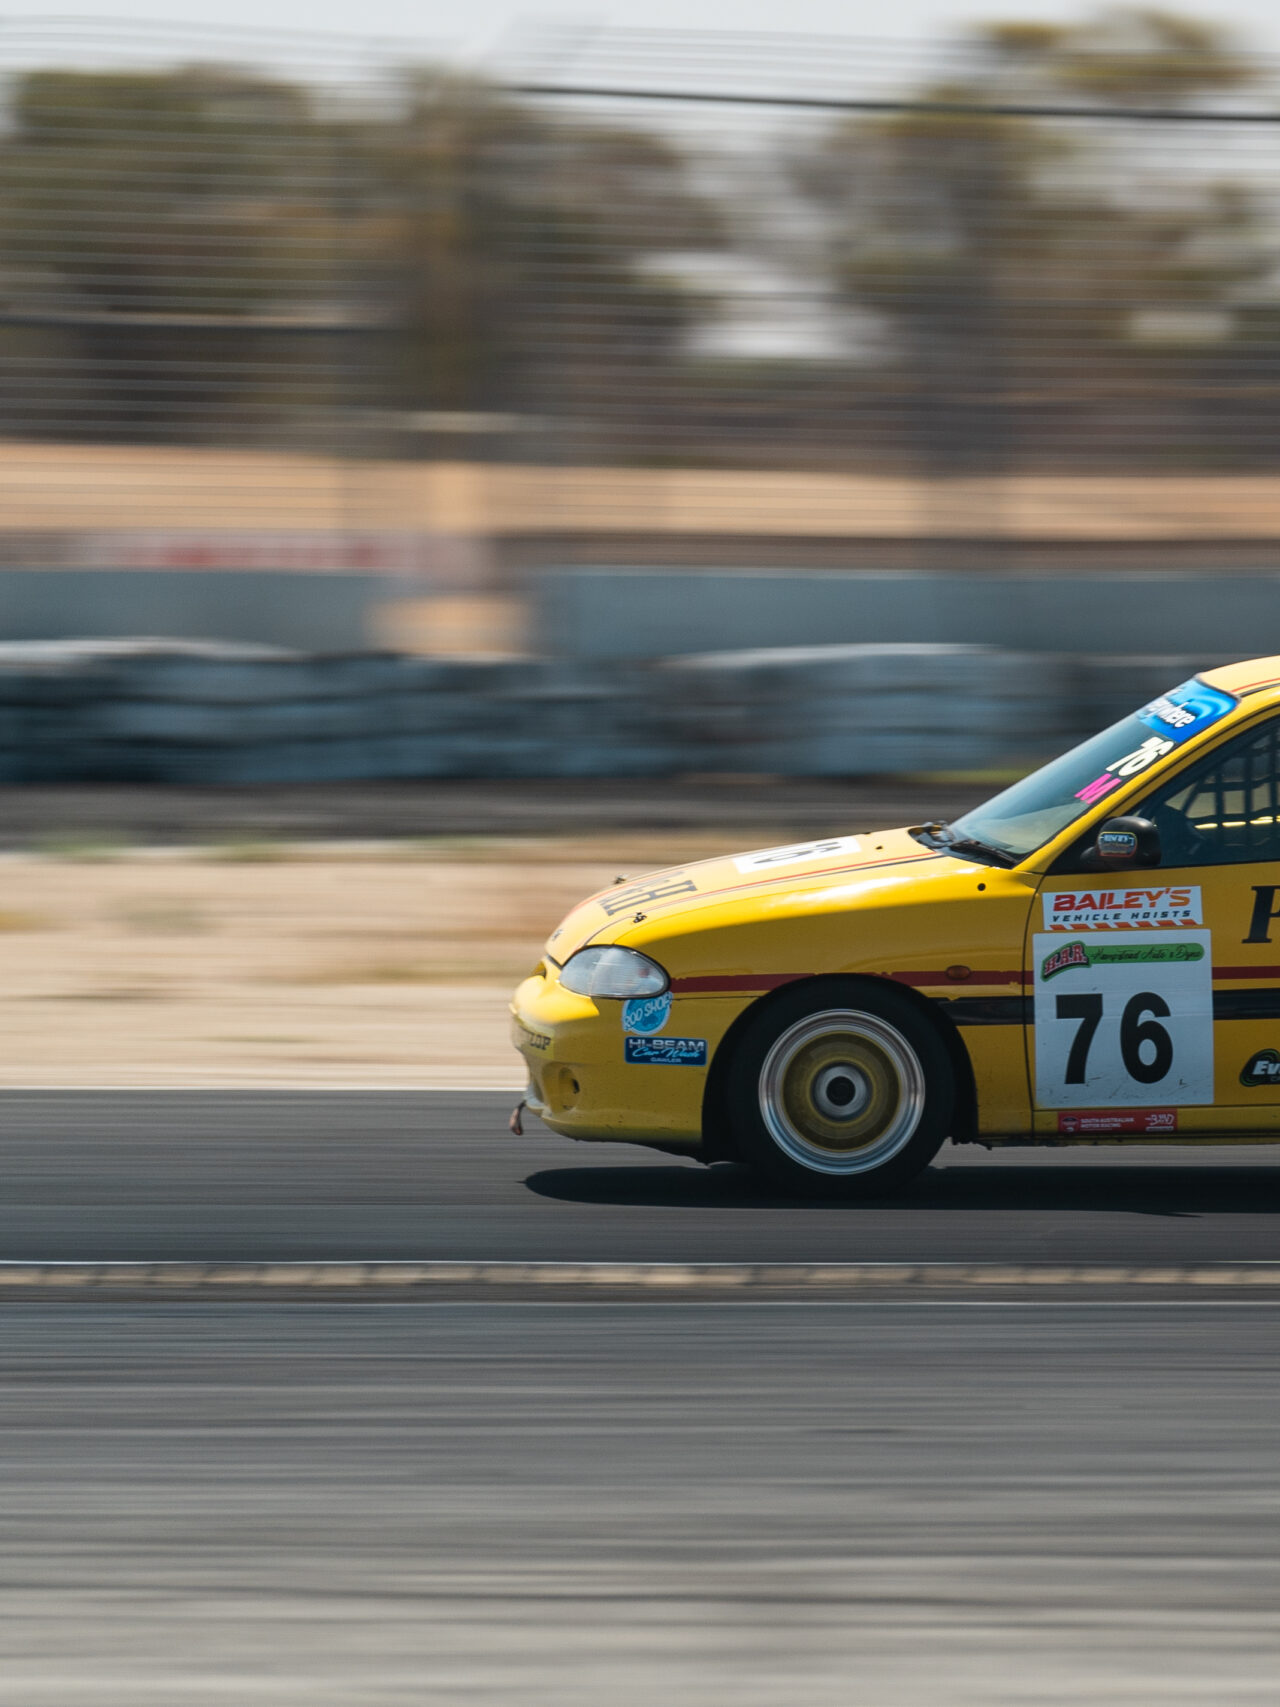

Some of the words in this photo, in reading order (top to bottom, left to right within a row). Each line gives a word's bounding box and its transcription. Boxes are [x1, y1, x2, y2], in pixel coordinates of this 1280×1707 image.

[1106, 737, 1174, 776] 76
[1053, 888, 1192, 911] BAILEY'S
[1053, 912, 1121, 922] VEHICLE
[1131, 910, 1191, 919] HOISTS
[629, 1038, 704, 1051] HI-BEAM
[1056, 991, 1173, 1084] 76
